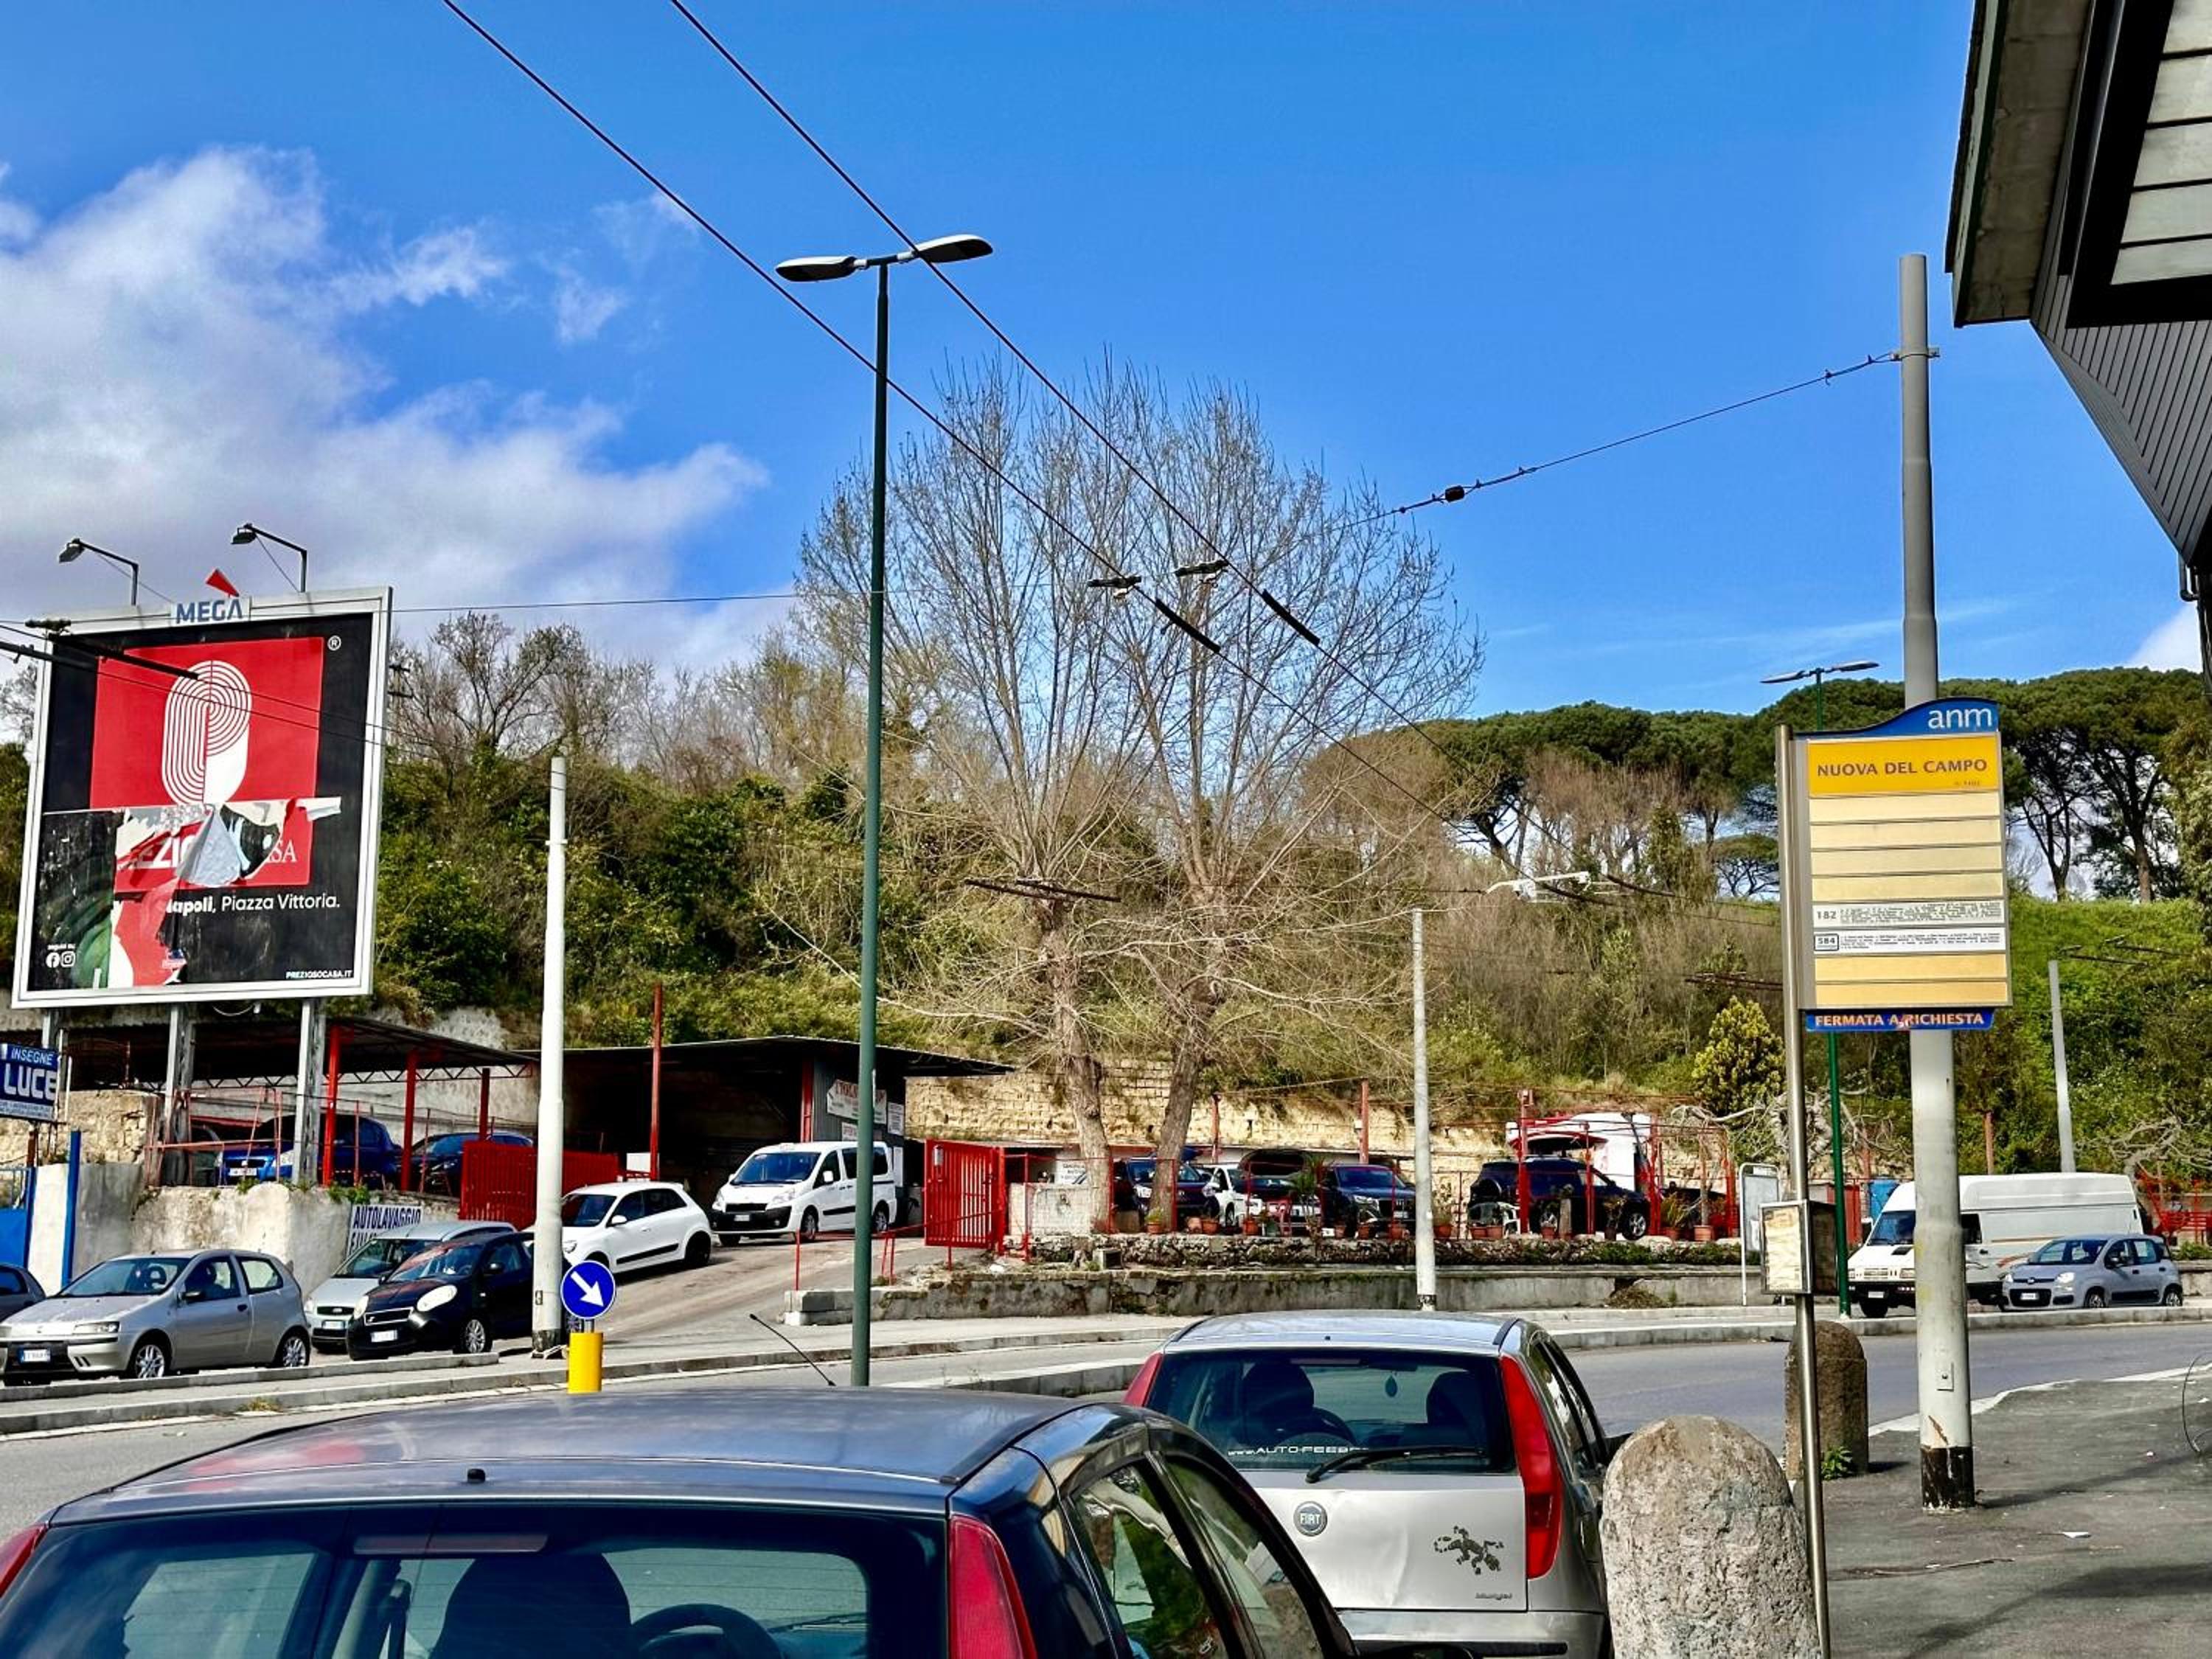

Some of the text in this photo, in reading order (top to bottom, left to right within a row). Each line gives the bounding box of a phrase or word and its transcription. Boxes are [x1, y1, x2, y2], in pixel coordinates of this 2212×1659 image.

[176, 599, 243, 624] MEGA
[1928, 708, 1992, 728] anm
[1818, 759, 1987, 776] NUOVA DEL CAMPO
[222, 896, 274, 911] Piazza
[277, 893, 340, 909] Vittoria.
[1817, 911, 1837, 920] 182
[1815, 1013, 1984, 1026] FERMATA A RICHIESTA
[11, 1047, 54, 1066] INSEGNE
[4, 1063, 58, 1102] LUCE
[353, 1206, 422, 1230] AUTOLAVAGGIO
[1300, 1513, 1321, 1524] FIAT
